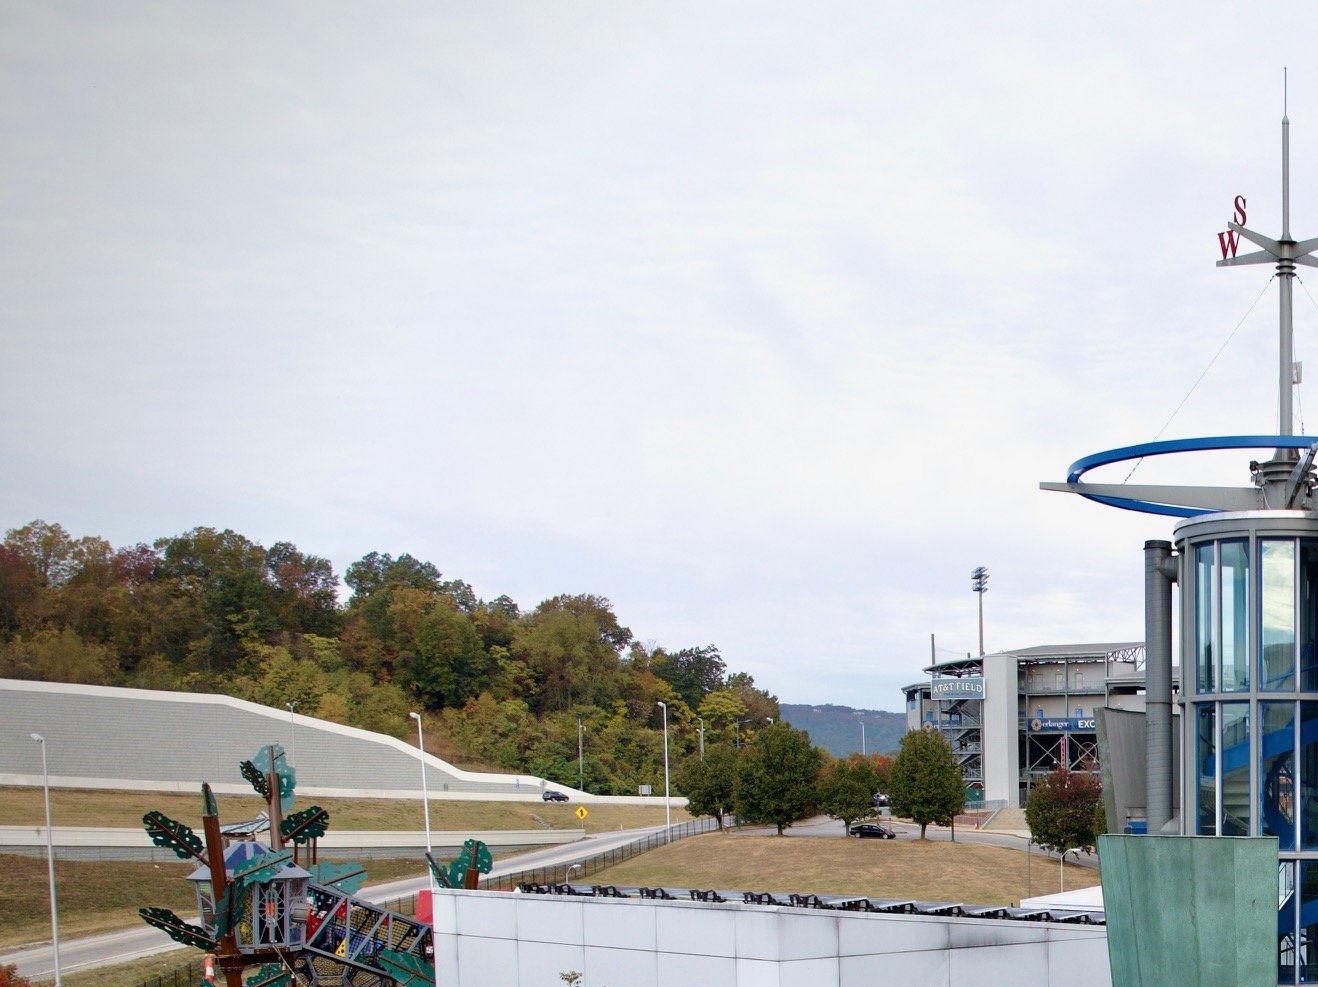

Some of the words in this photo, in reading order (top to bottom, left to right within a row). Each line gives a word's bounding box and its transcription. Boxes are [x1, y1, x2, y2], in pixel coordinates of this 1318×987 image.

[1233, 195, 1247, 227] S
[1217, 229, 1241, 260] W
[933, 683, 955, 694] AT&T
[956, 682, 983, 693] FIELD
[1042, 720, 1069, 729] erlanger
